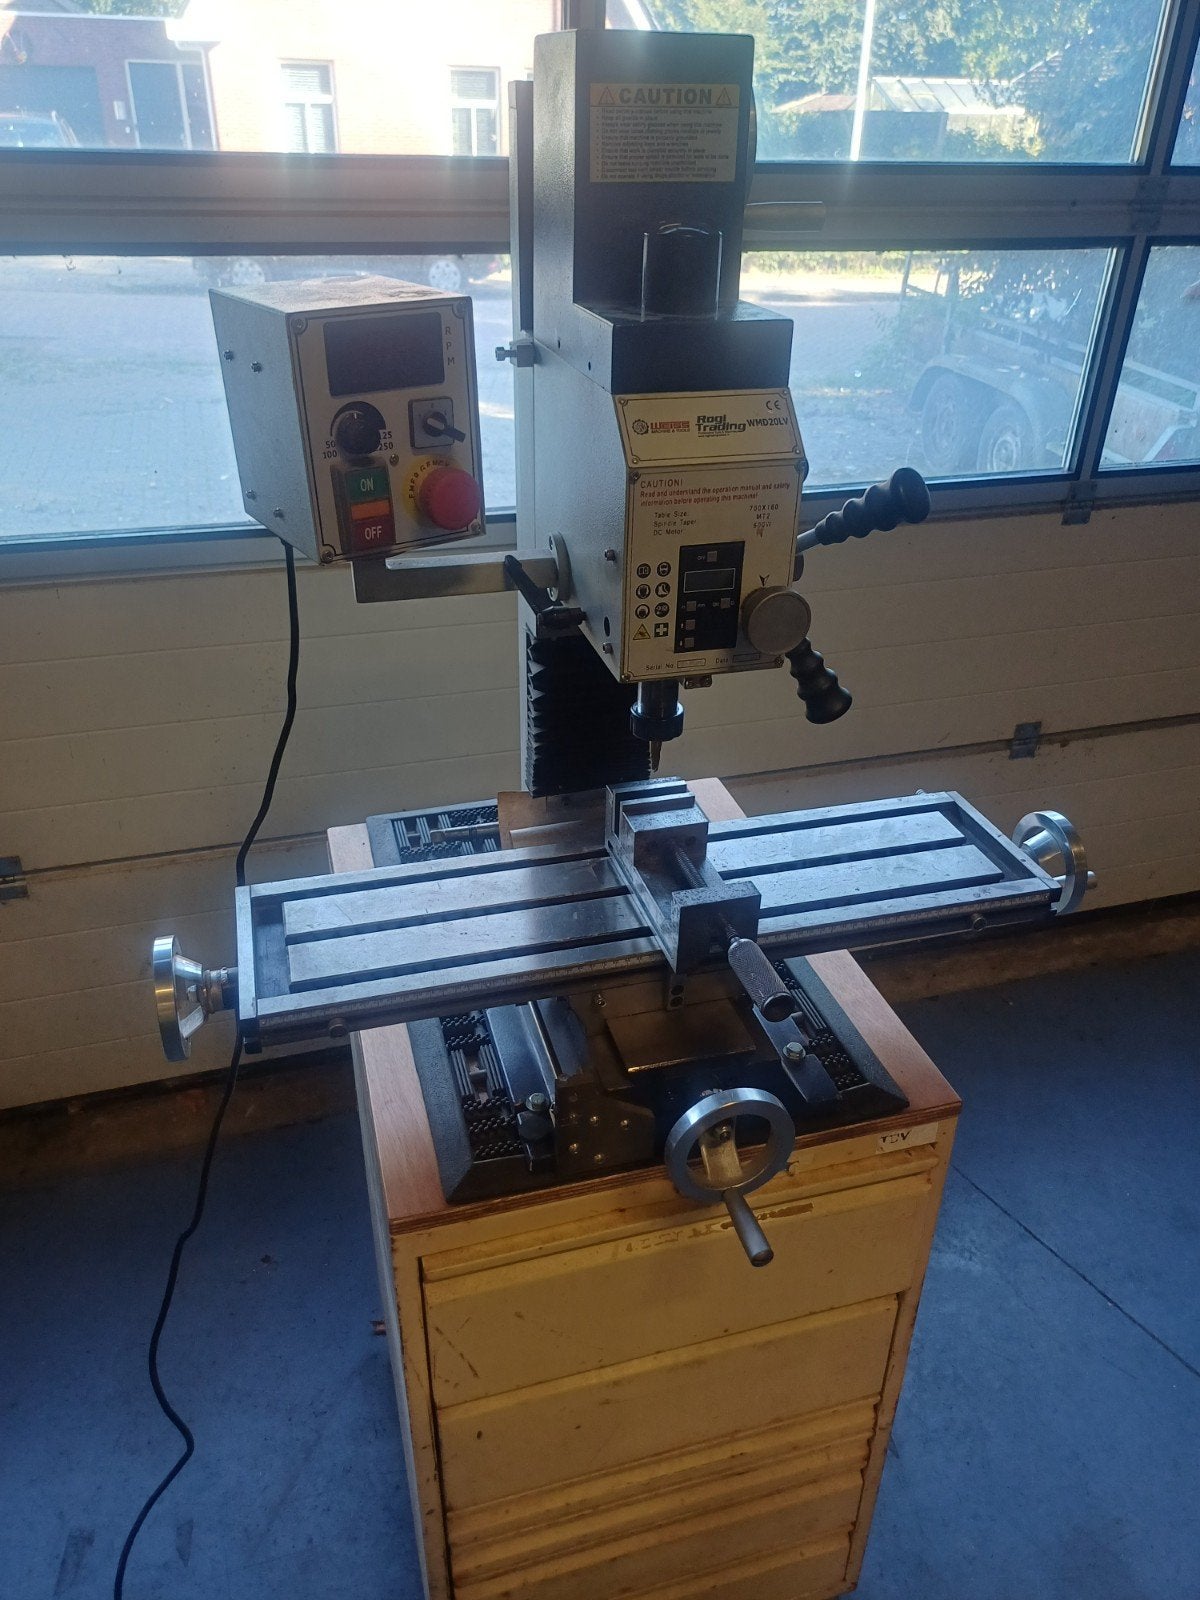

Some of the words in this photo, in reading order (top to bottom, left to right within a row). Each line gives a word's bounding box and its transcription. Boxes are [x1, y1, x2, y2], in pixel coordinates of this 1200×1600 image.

[618, 88, 712, 105] CAUTION
[746, 417, 789, 427] WMD20LV
[695, 422, 747, 433] Trading
[325, 440, 336, 448] 50
[323, 450, 338, 459] 100
[360, 477, 374, 491] ON
[640, 479, 683, 489] CAUTION!
[364, 525, 383, 540] OFF
